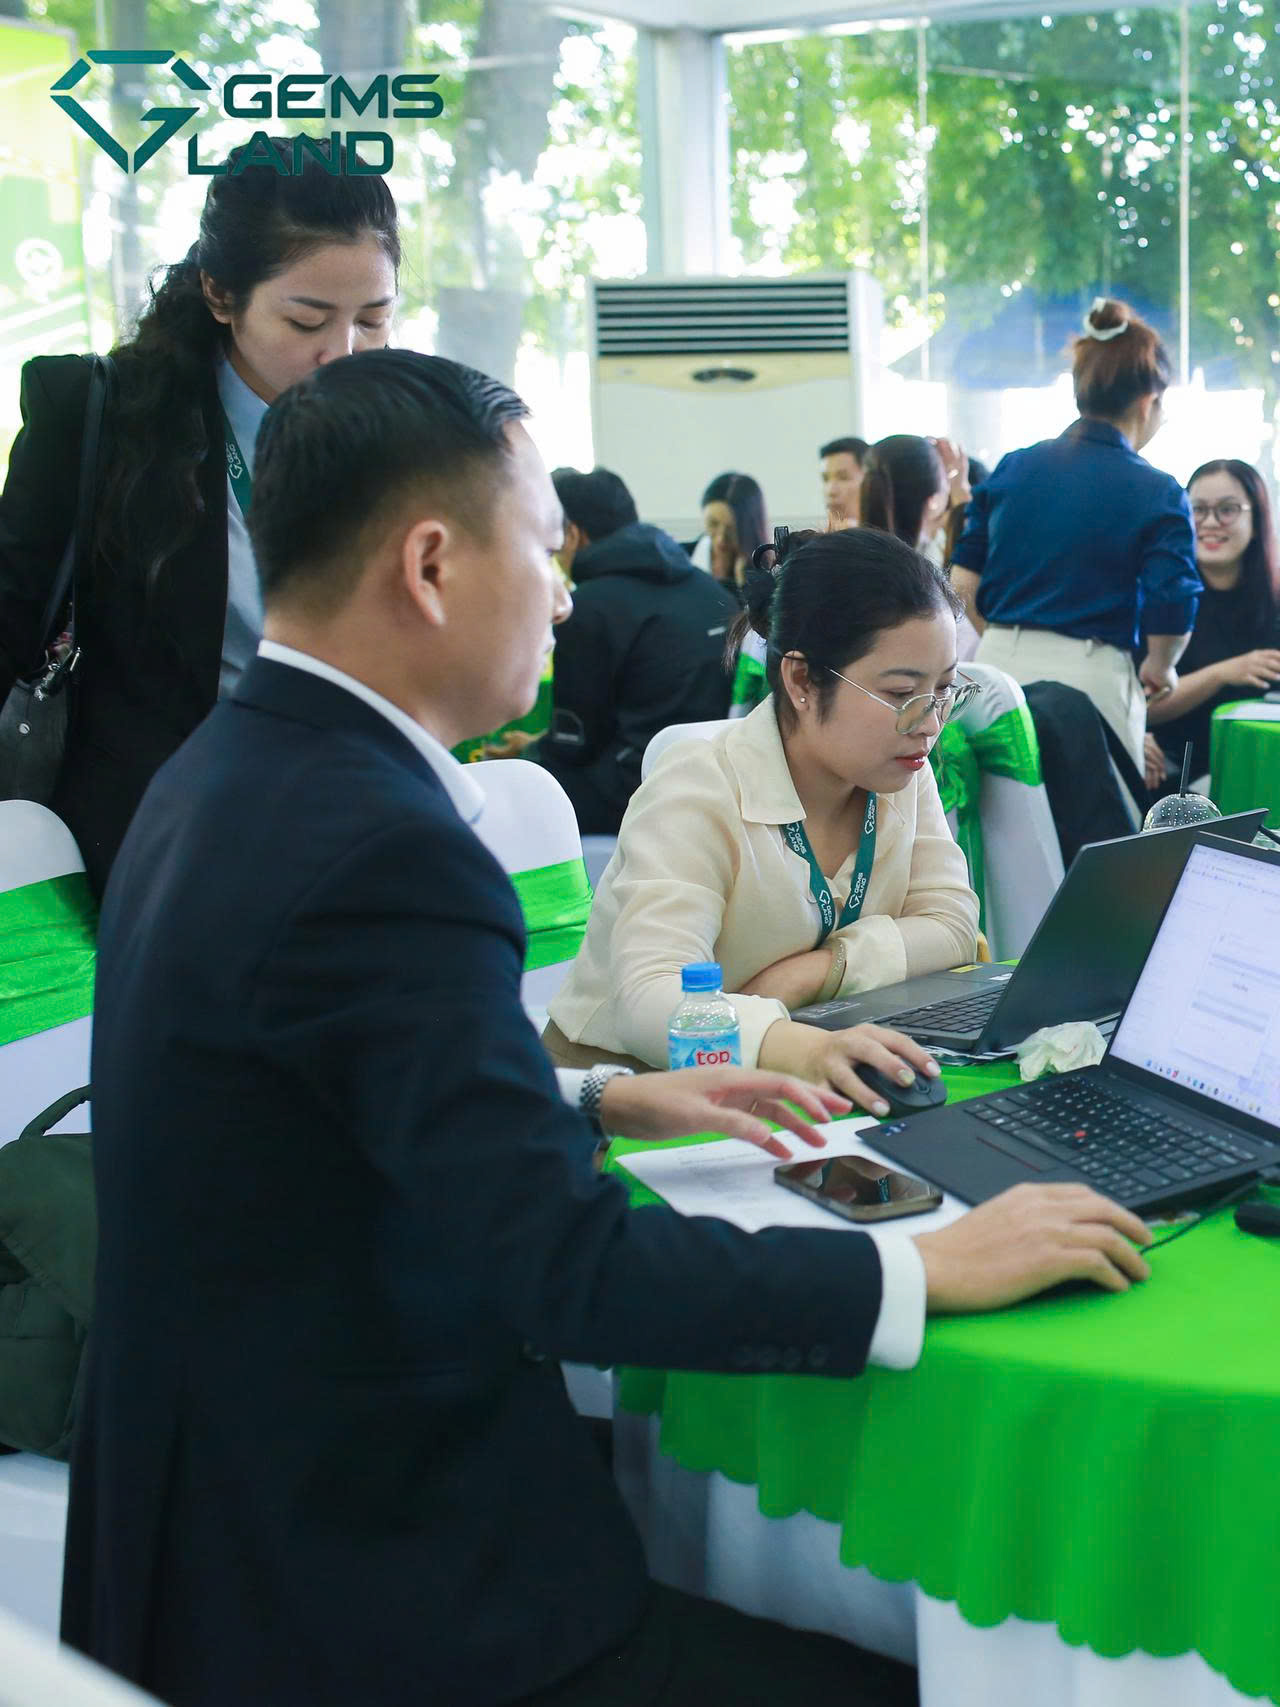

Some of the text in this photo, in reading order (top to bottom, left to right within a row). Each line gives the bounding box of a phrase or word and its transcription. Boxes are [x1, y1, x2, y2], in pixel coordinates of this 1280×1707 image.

[788, 831, 800, 852] LAND
[854, 872, 864, 893] GEMS
[858, 877, 867, 898] LAND
[697, 1051, 730, 1066] top
